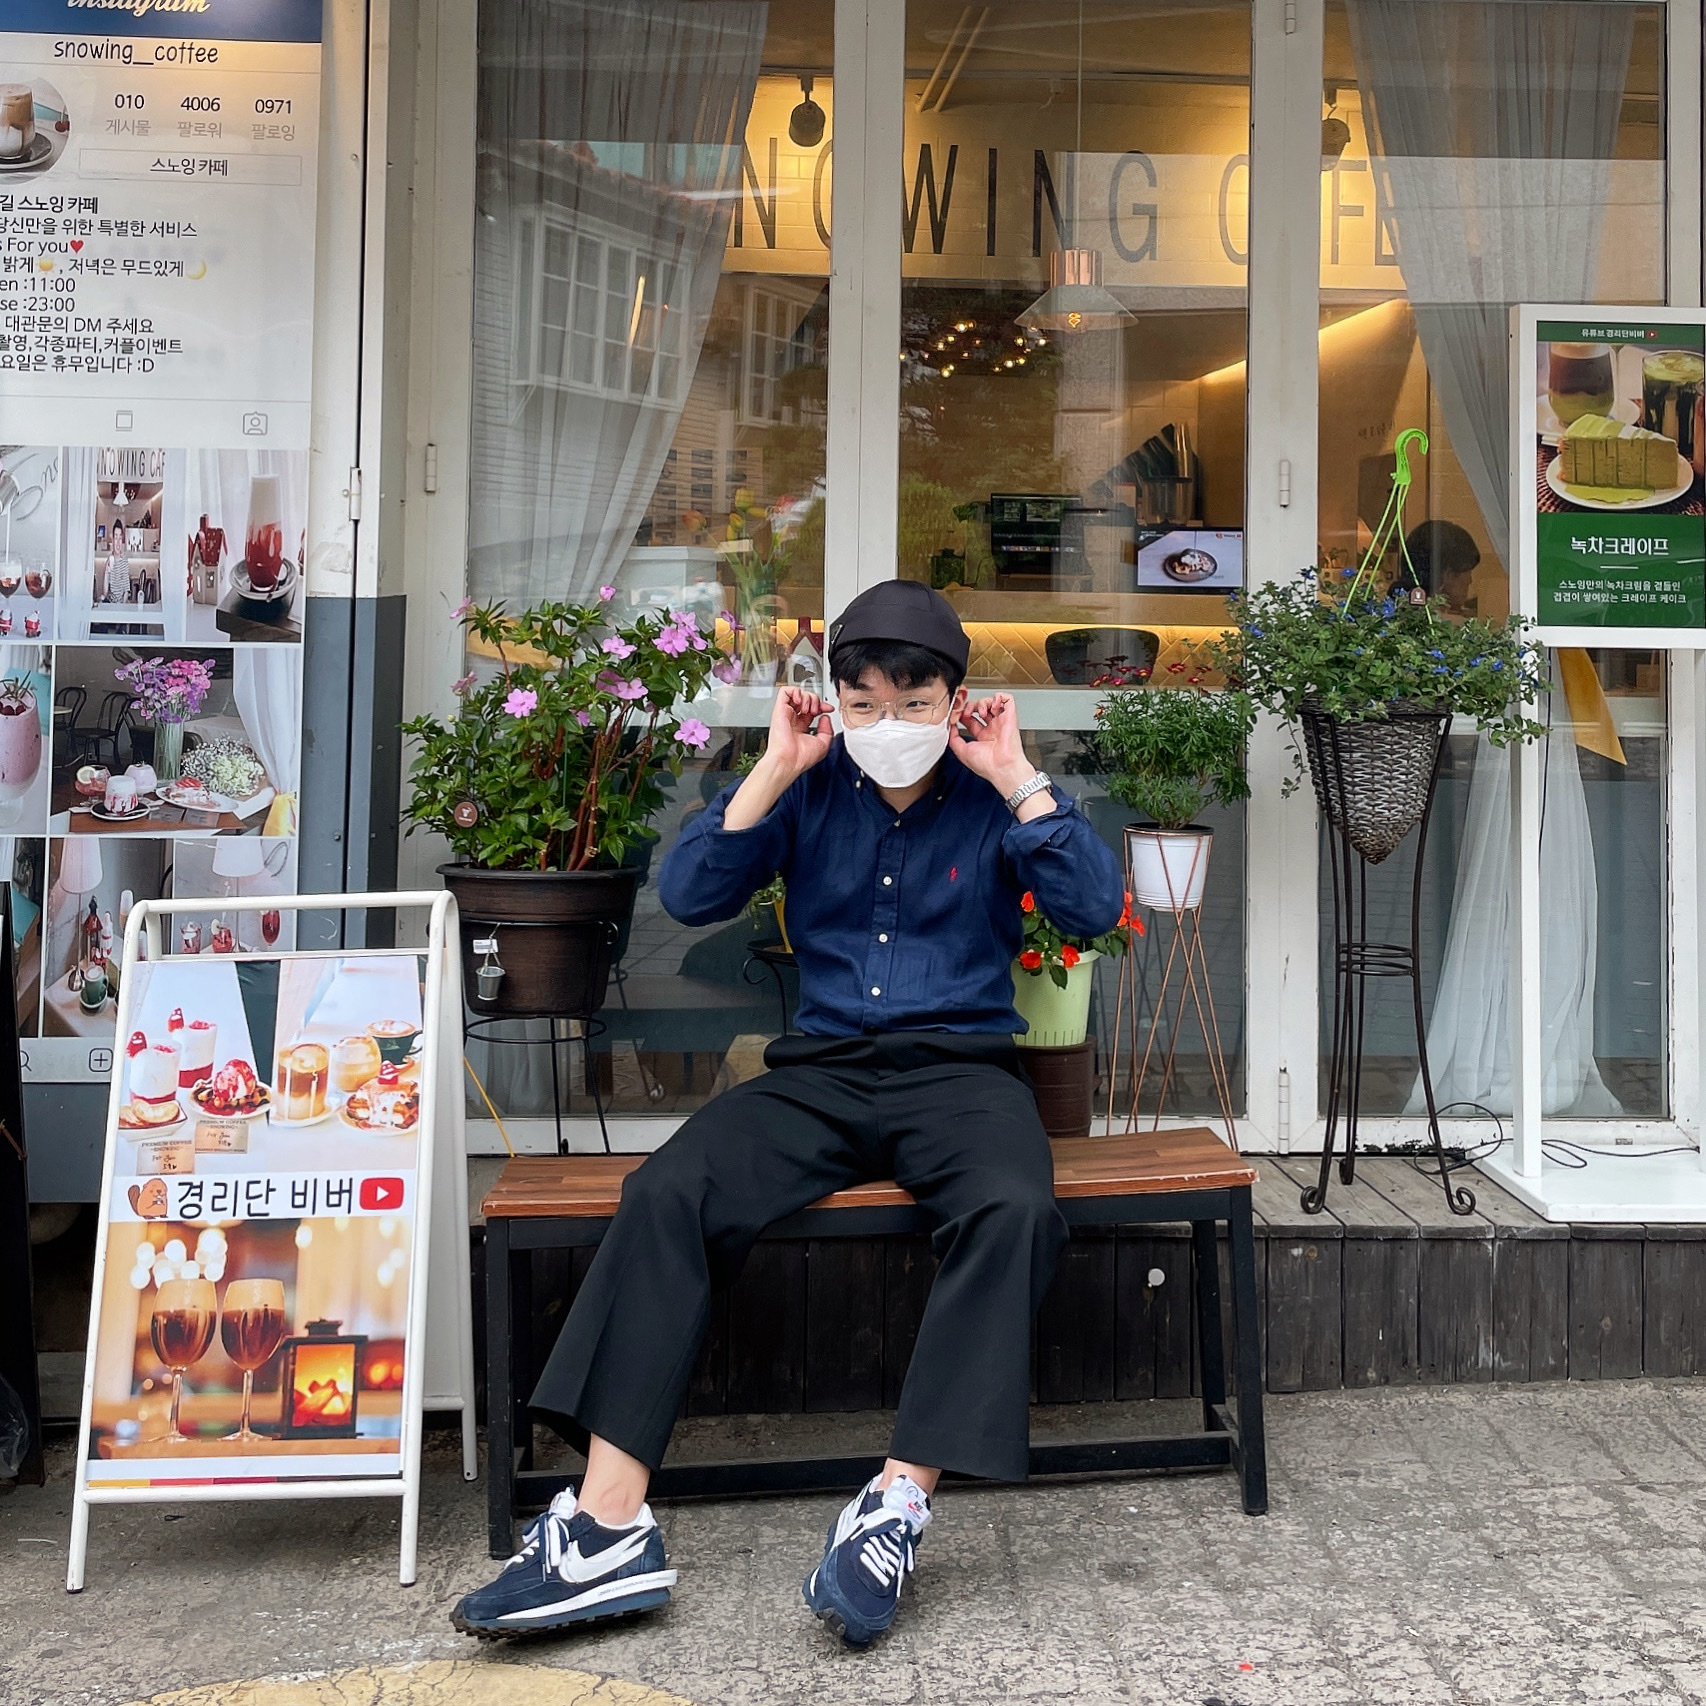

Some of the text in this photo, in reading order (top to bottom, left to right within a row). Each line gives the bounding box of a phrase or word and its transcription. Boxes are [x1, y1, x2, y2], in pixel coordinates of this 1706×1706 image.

[114, 94, 291, 114] 010 4006 0971
[105, 119, 296, 142] 게시물 팔로워 팔로잉
[149, 159, 228, 177] 스노잉 카페
[17, 196, 64, 214] 스노잉
[67, 197, 99, 215] 카페
[61, 219, 94, 236] 위한
[97, 220, 147, 238] 특별한
[149, 222, 198, 239] 서비스
[7, 238, 35, 253] For
[37, 242, 69, 257] you
[68, 258, 117, 276] 저녁은
[120, 260, 184, 278] 무드있게
[5, 316, 154, 336] 대관문의 DM 주세요
[51, 355, 133, 375] 휴무입니다
[137, 359, 155, 373] :D
[1570, 537, 1669, 556] 녹차크레이프
[1558, 580, 1604, 591] 스노잉만의
[1621, 594, 1657, 604] 크레이프
[1659, 594, 1687, 604] 케이크
[177, 1178, 353, 1219] 경리단 비버
